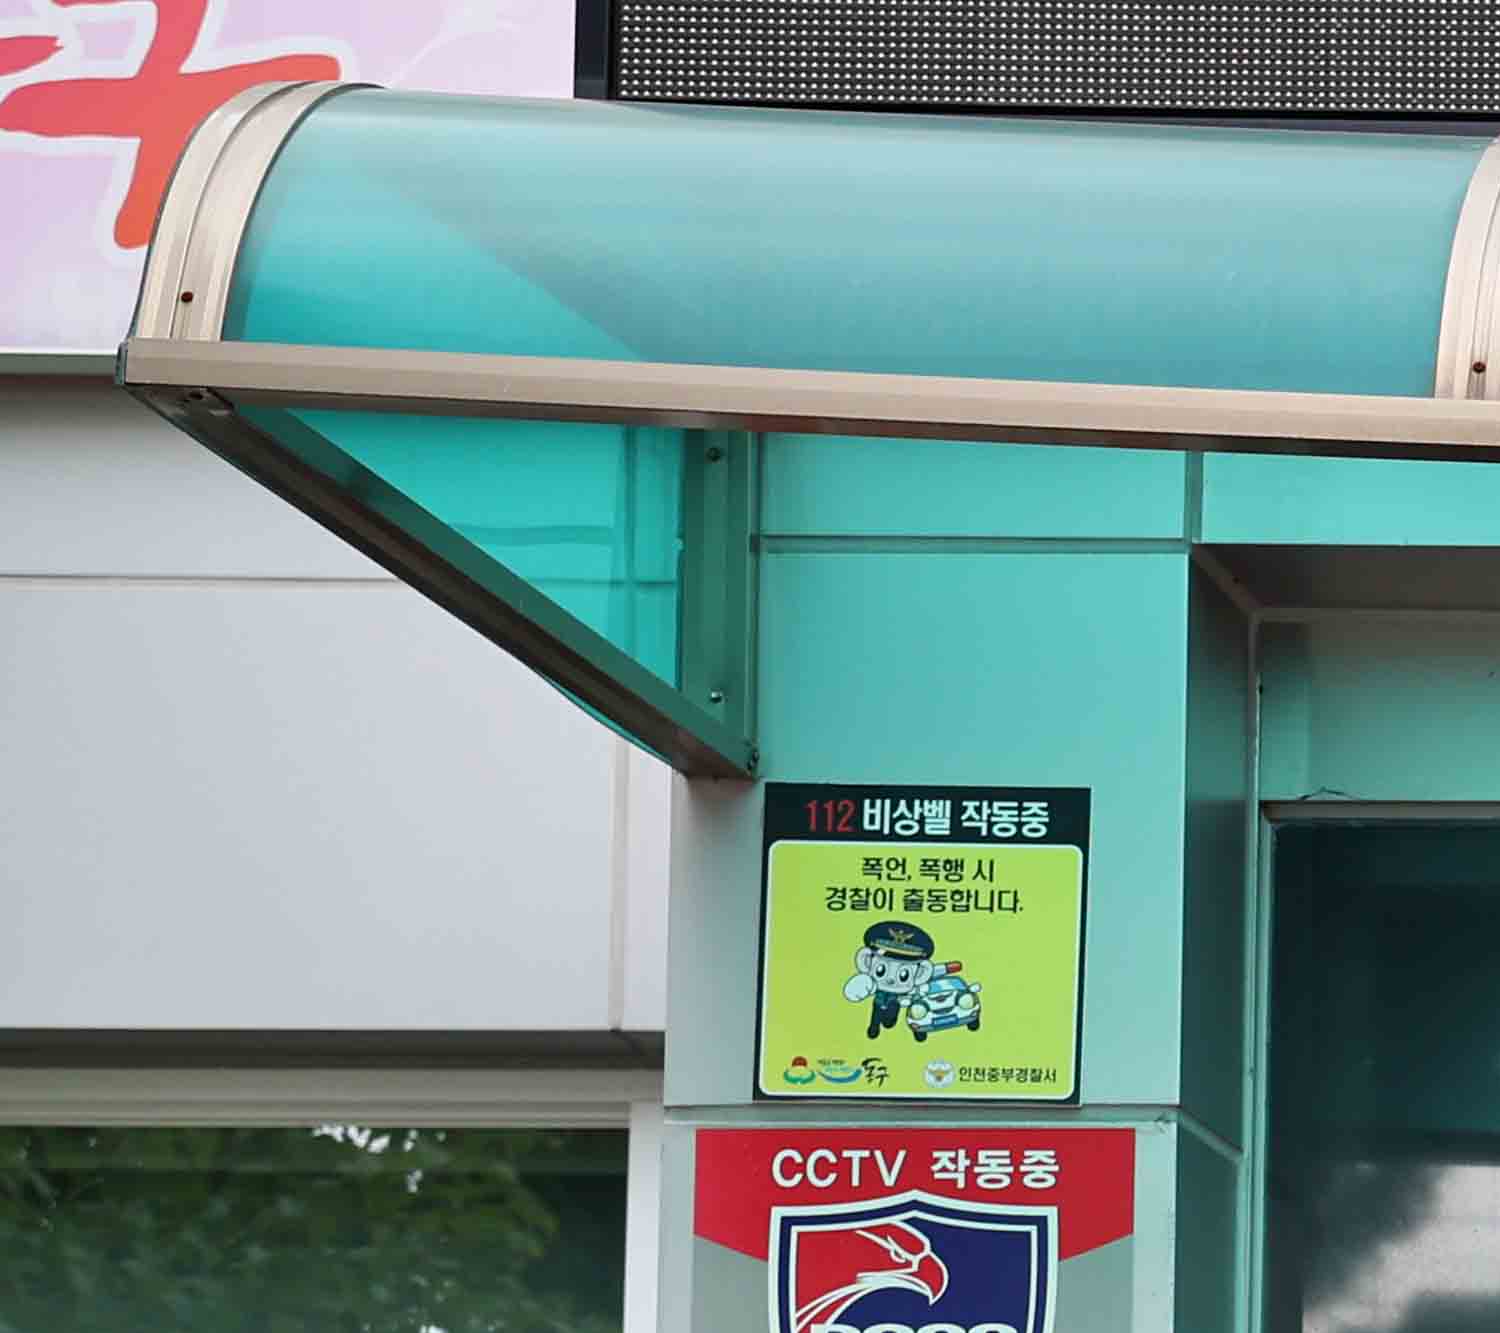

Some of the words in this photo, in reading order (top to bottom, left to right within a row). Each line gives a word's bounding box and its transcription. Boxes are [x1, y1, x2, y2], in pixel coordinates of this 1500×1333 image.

[805, 800, 857, 833] 112
[861, 799, 951, 837] 비상벨
[960, 801, 1050, 837] 작동중
[861, 857, 912, 882] 폭언,
[919, 857, 965, 882] 폭행
[972, 858, 995, 882] 시
[824, 886, 895, 912] 경찰이
[902, 887, 1024, 914] 출동합니다.
[958, 1065, 1057, 1085] 인천중부경찰서
[770, 1148, 907, 1188] CCTV
[930, 1149, 1060, 1190] 작동중
